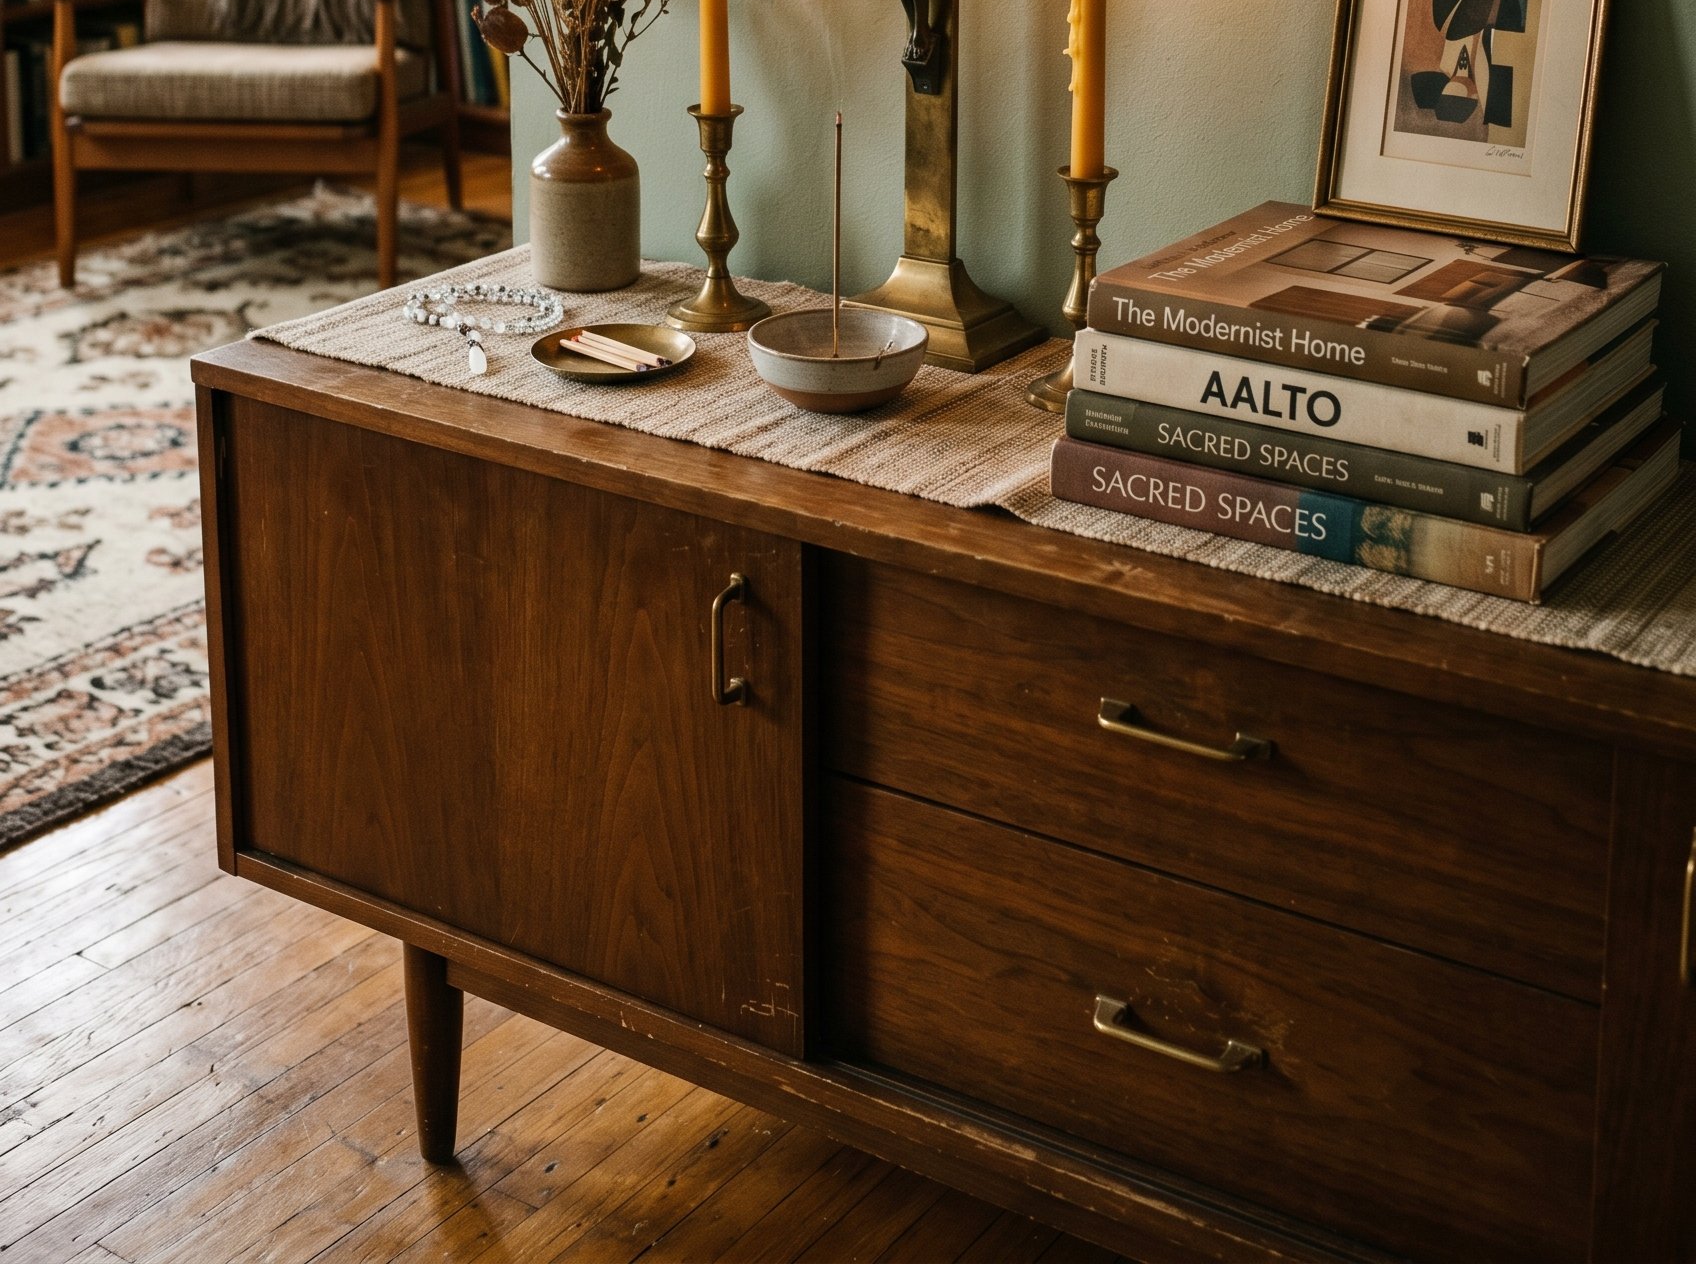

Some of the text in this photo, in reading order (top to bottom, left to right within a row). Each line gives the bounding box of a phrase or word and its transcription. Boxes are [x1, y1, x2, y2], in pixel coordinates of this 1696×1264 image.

[1147, 267, 1197, 282] The
[1258, 214, 1315, 237] Home
[1112, 297, 1155, 327] The
[1163, 306, 1283, 351] Modernist
[1291, 328, 1366, 365] Home
[1200, 370, 1342, 428] AALTO
[1157, 423, 1251, 460] SACRED
[1259, 444, 1349, 481] SPACES
[1092, 466, 1327, 540] SACRED SPACES
